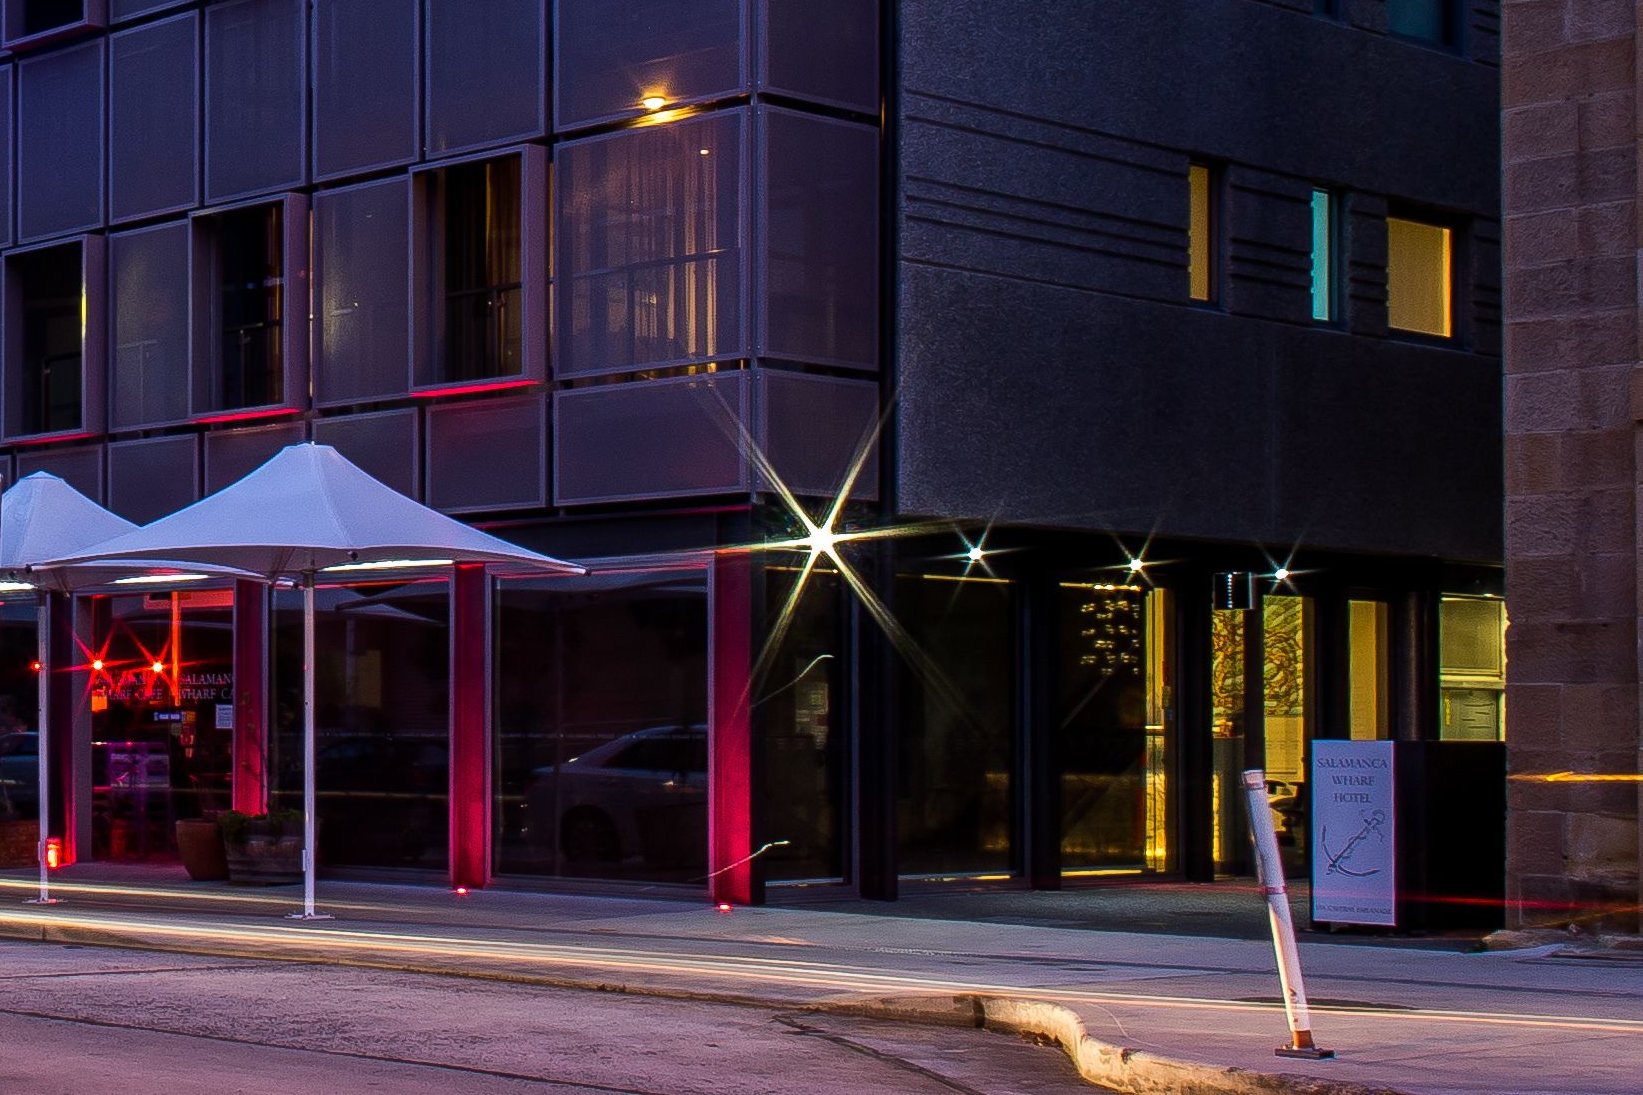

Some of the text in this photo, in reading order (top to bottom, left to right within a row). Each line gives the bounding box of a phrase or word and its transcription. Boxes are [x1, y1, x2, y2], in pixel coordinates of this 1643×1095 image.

[179, 688, 217, 700] WHARF
[1316, 757, 1388, 769] SALAMANCA
[1331, 775, 1375, 786] WHARF
[1334, 792, 1373, 804] HOTEL
